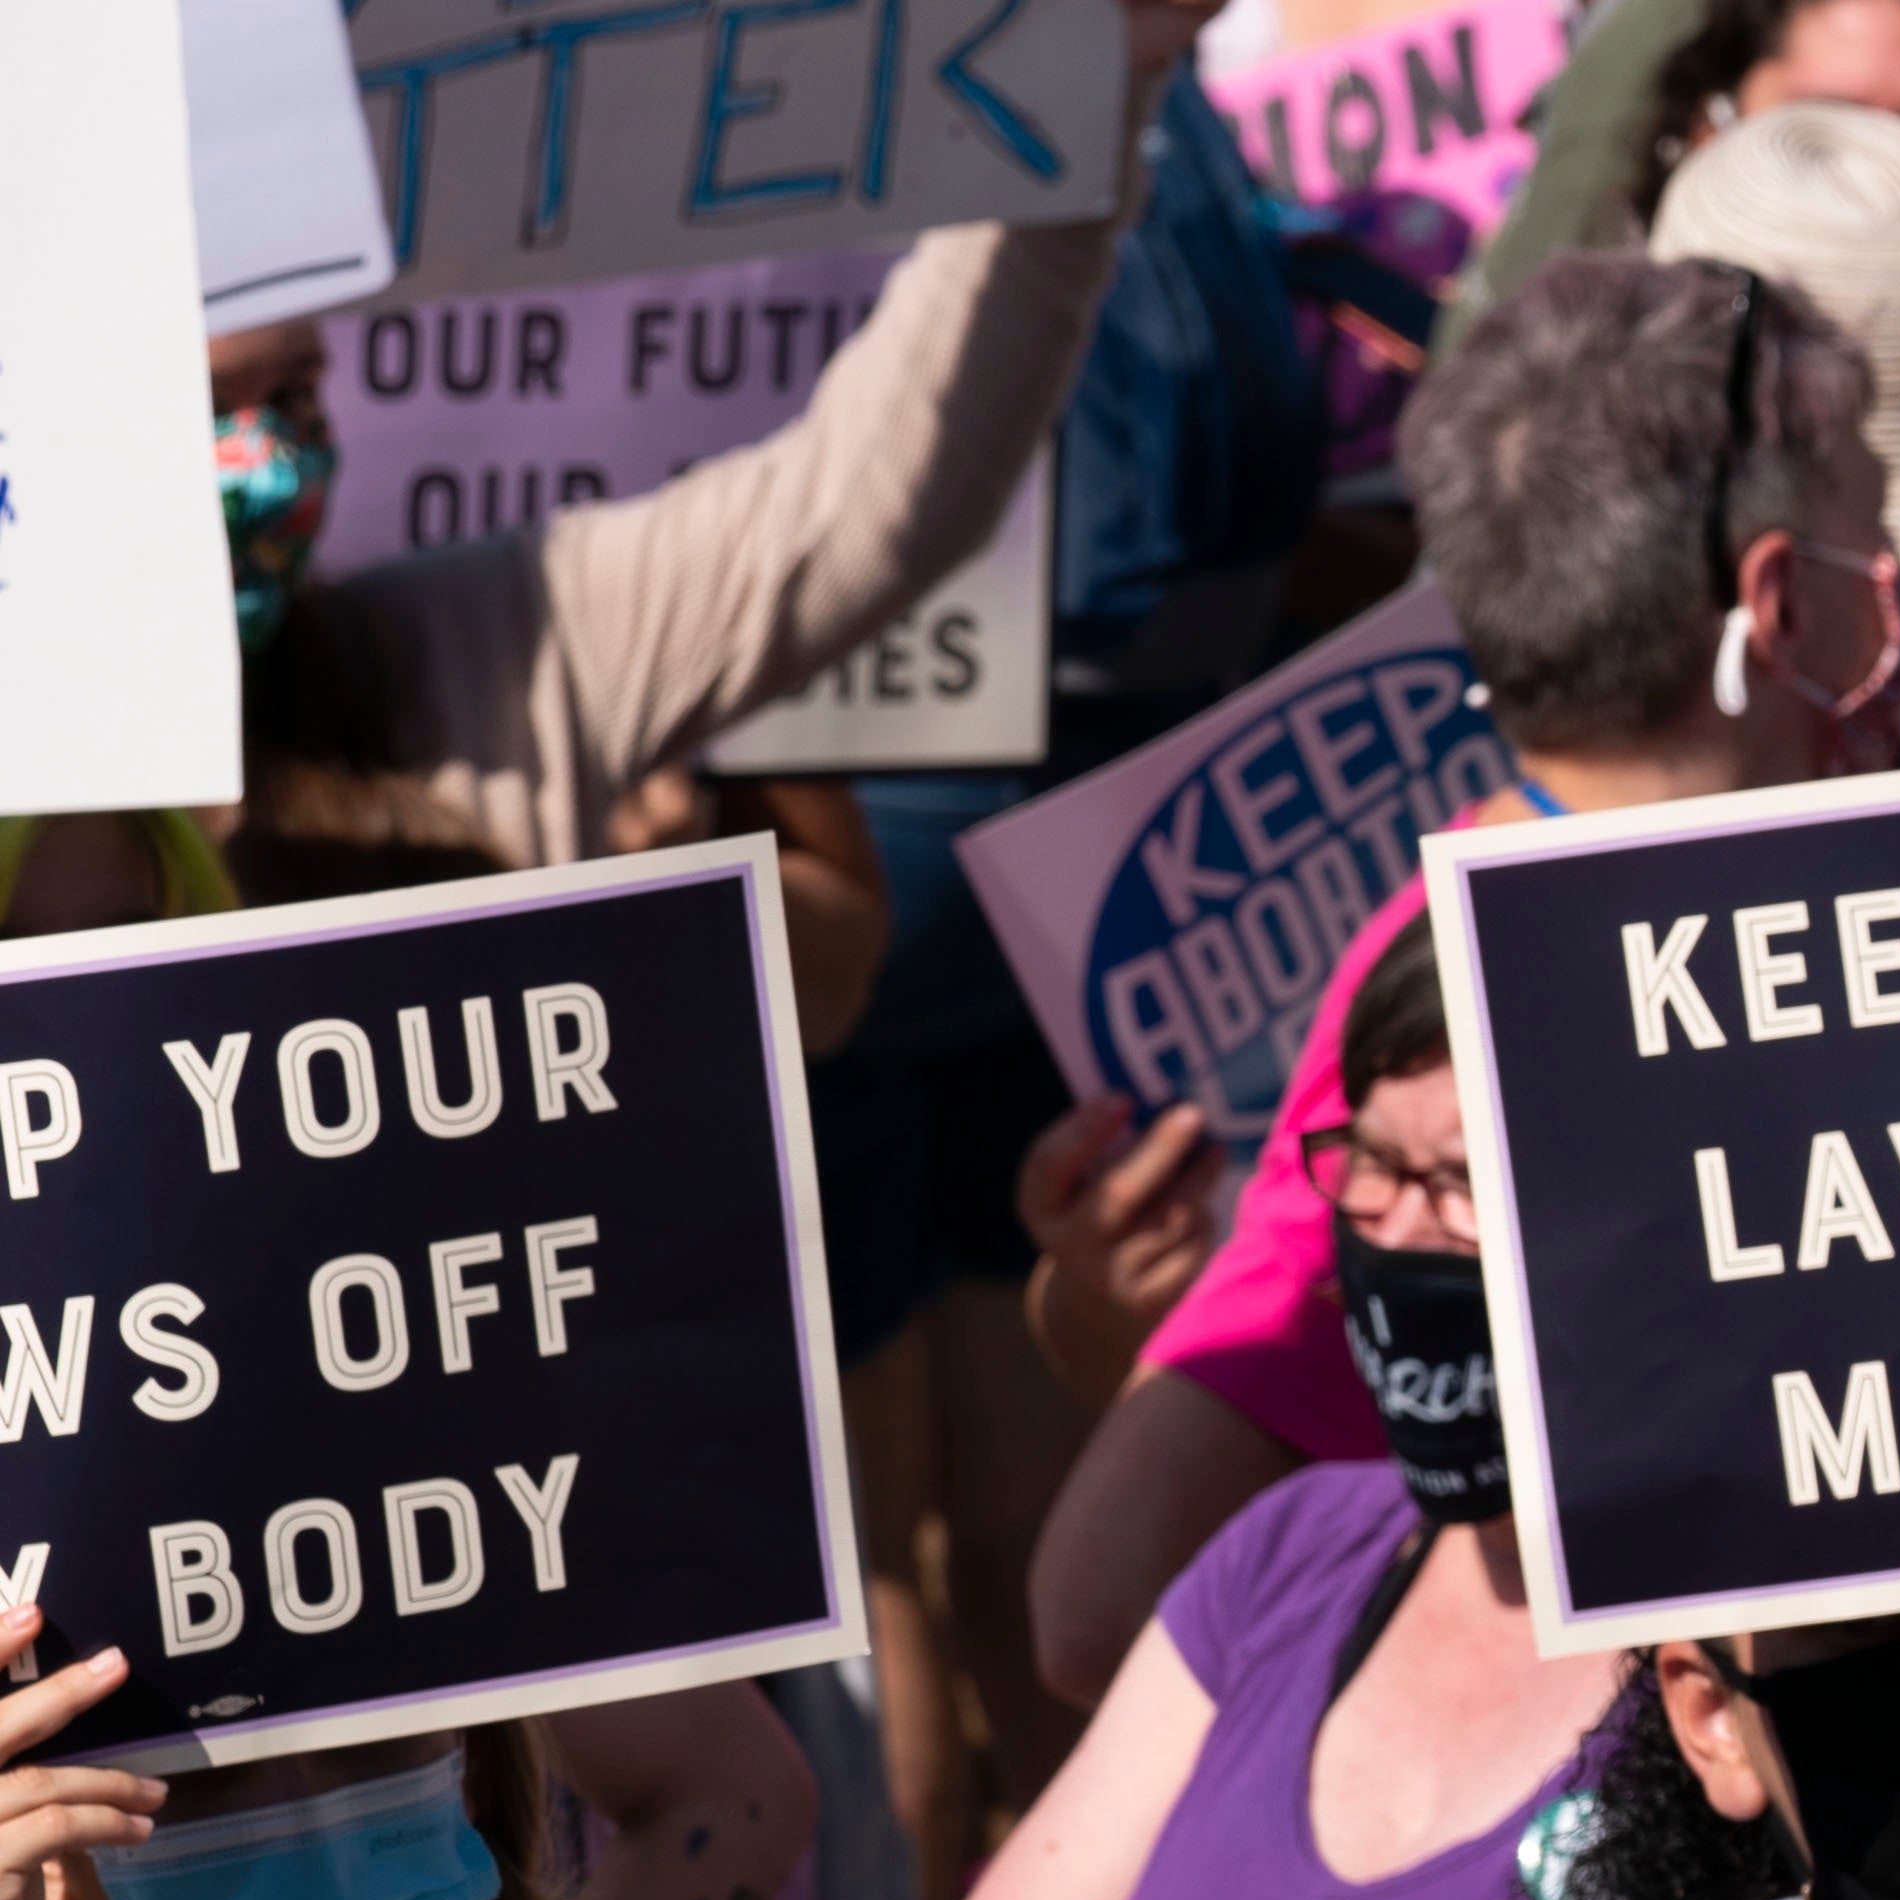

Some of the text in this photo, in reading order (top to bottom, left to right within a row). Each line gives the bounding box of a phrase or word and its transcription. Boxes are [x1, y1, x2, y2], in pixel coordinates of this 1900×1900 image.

[363, 307, 567, 397] OUR
[1140, 658, 1466, 925] KEEP
[162, 982, 619, 1174] YOUR
[308, 1215, 600, 1393] OFF
[148, 1453, 580, 1658] BODY
